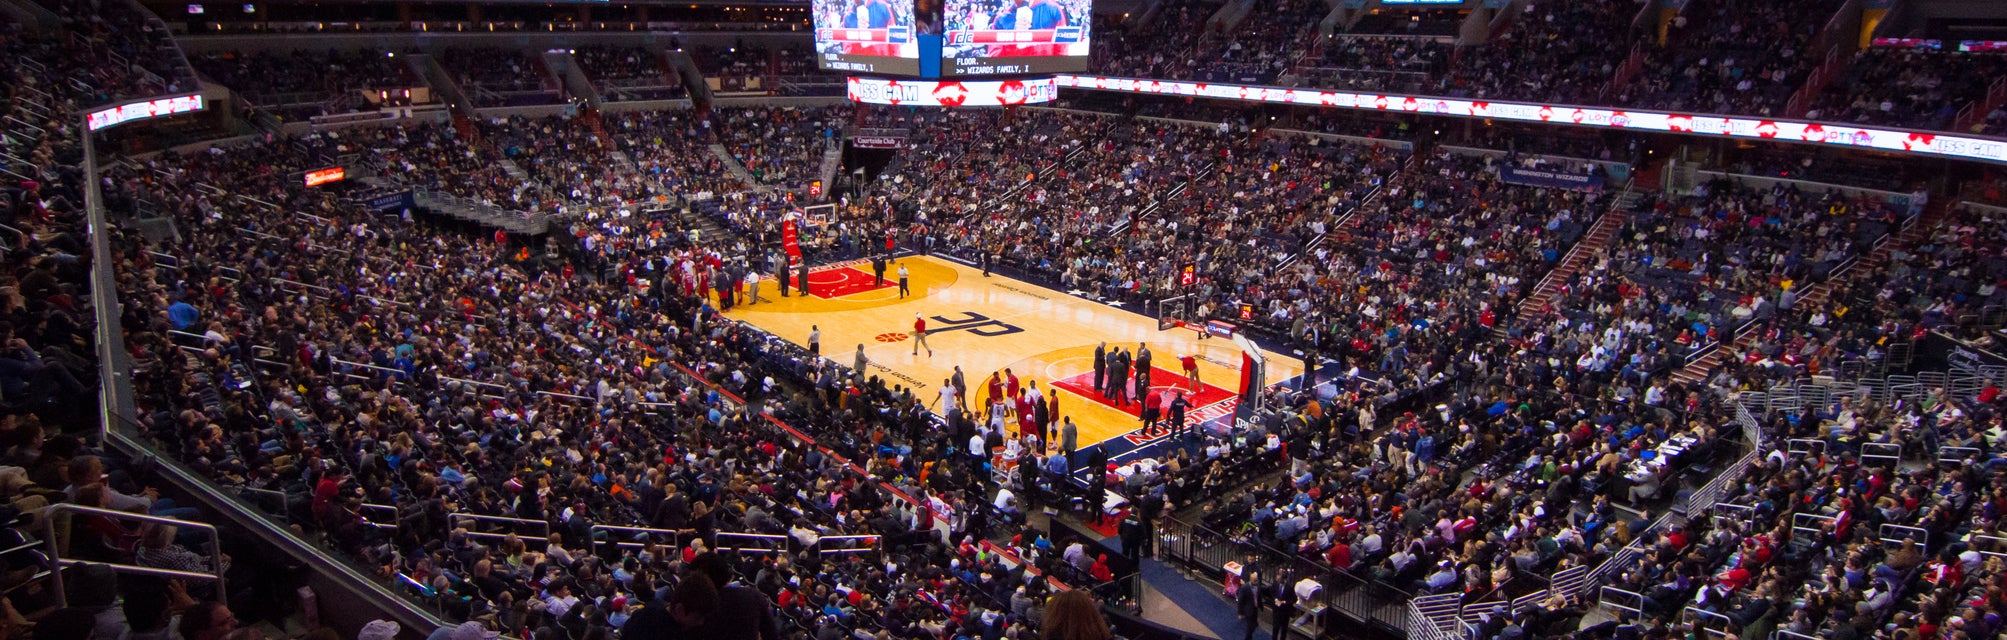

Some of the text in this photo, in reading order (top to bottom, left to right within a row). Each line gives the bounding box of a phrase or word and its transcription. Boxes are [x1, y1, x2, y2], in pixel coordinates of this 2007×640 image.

[967, 66, 994, 74] WIZARDS
[882, 83, 919, 101] CAM
[1970, 142, 2001, 157] CAM
[1513, 168, 1589, 183] WASHINGTON WIZARDS
[811, 186, 820, 194] 24
[373, 194, 402, 206] MASERATI
[1182, 272, 1193, 284] 24
